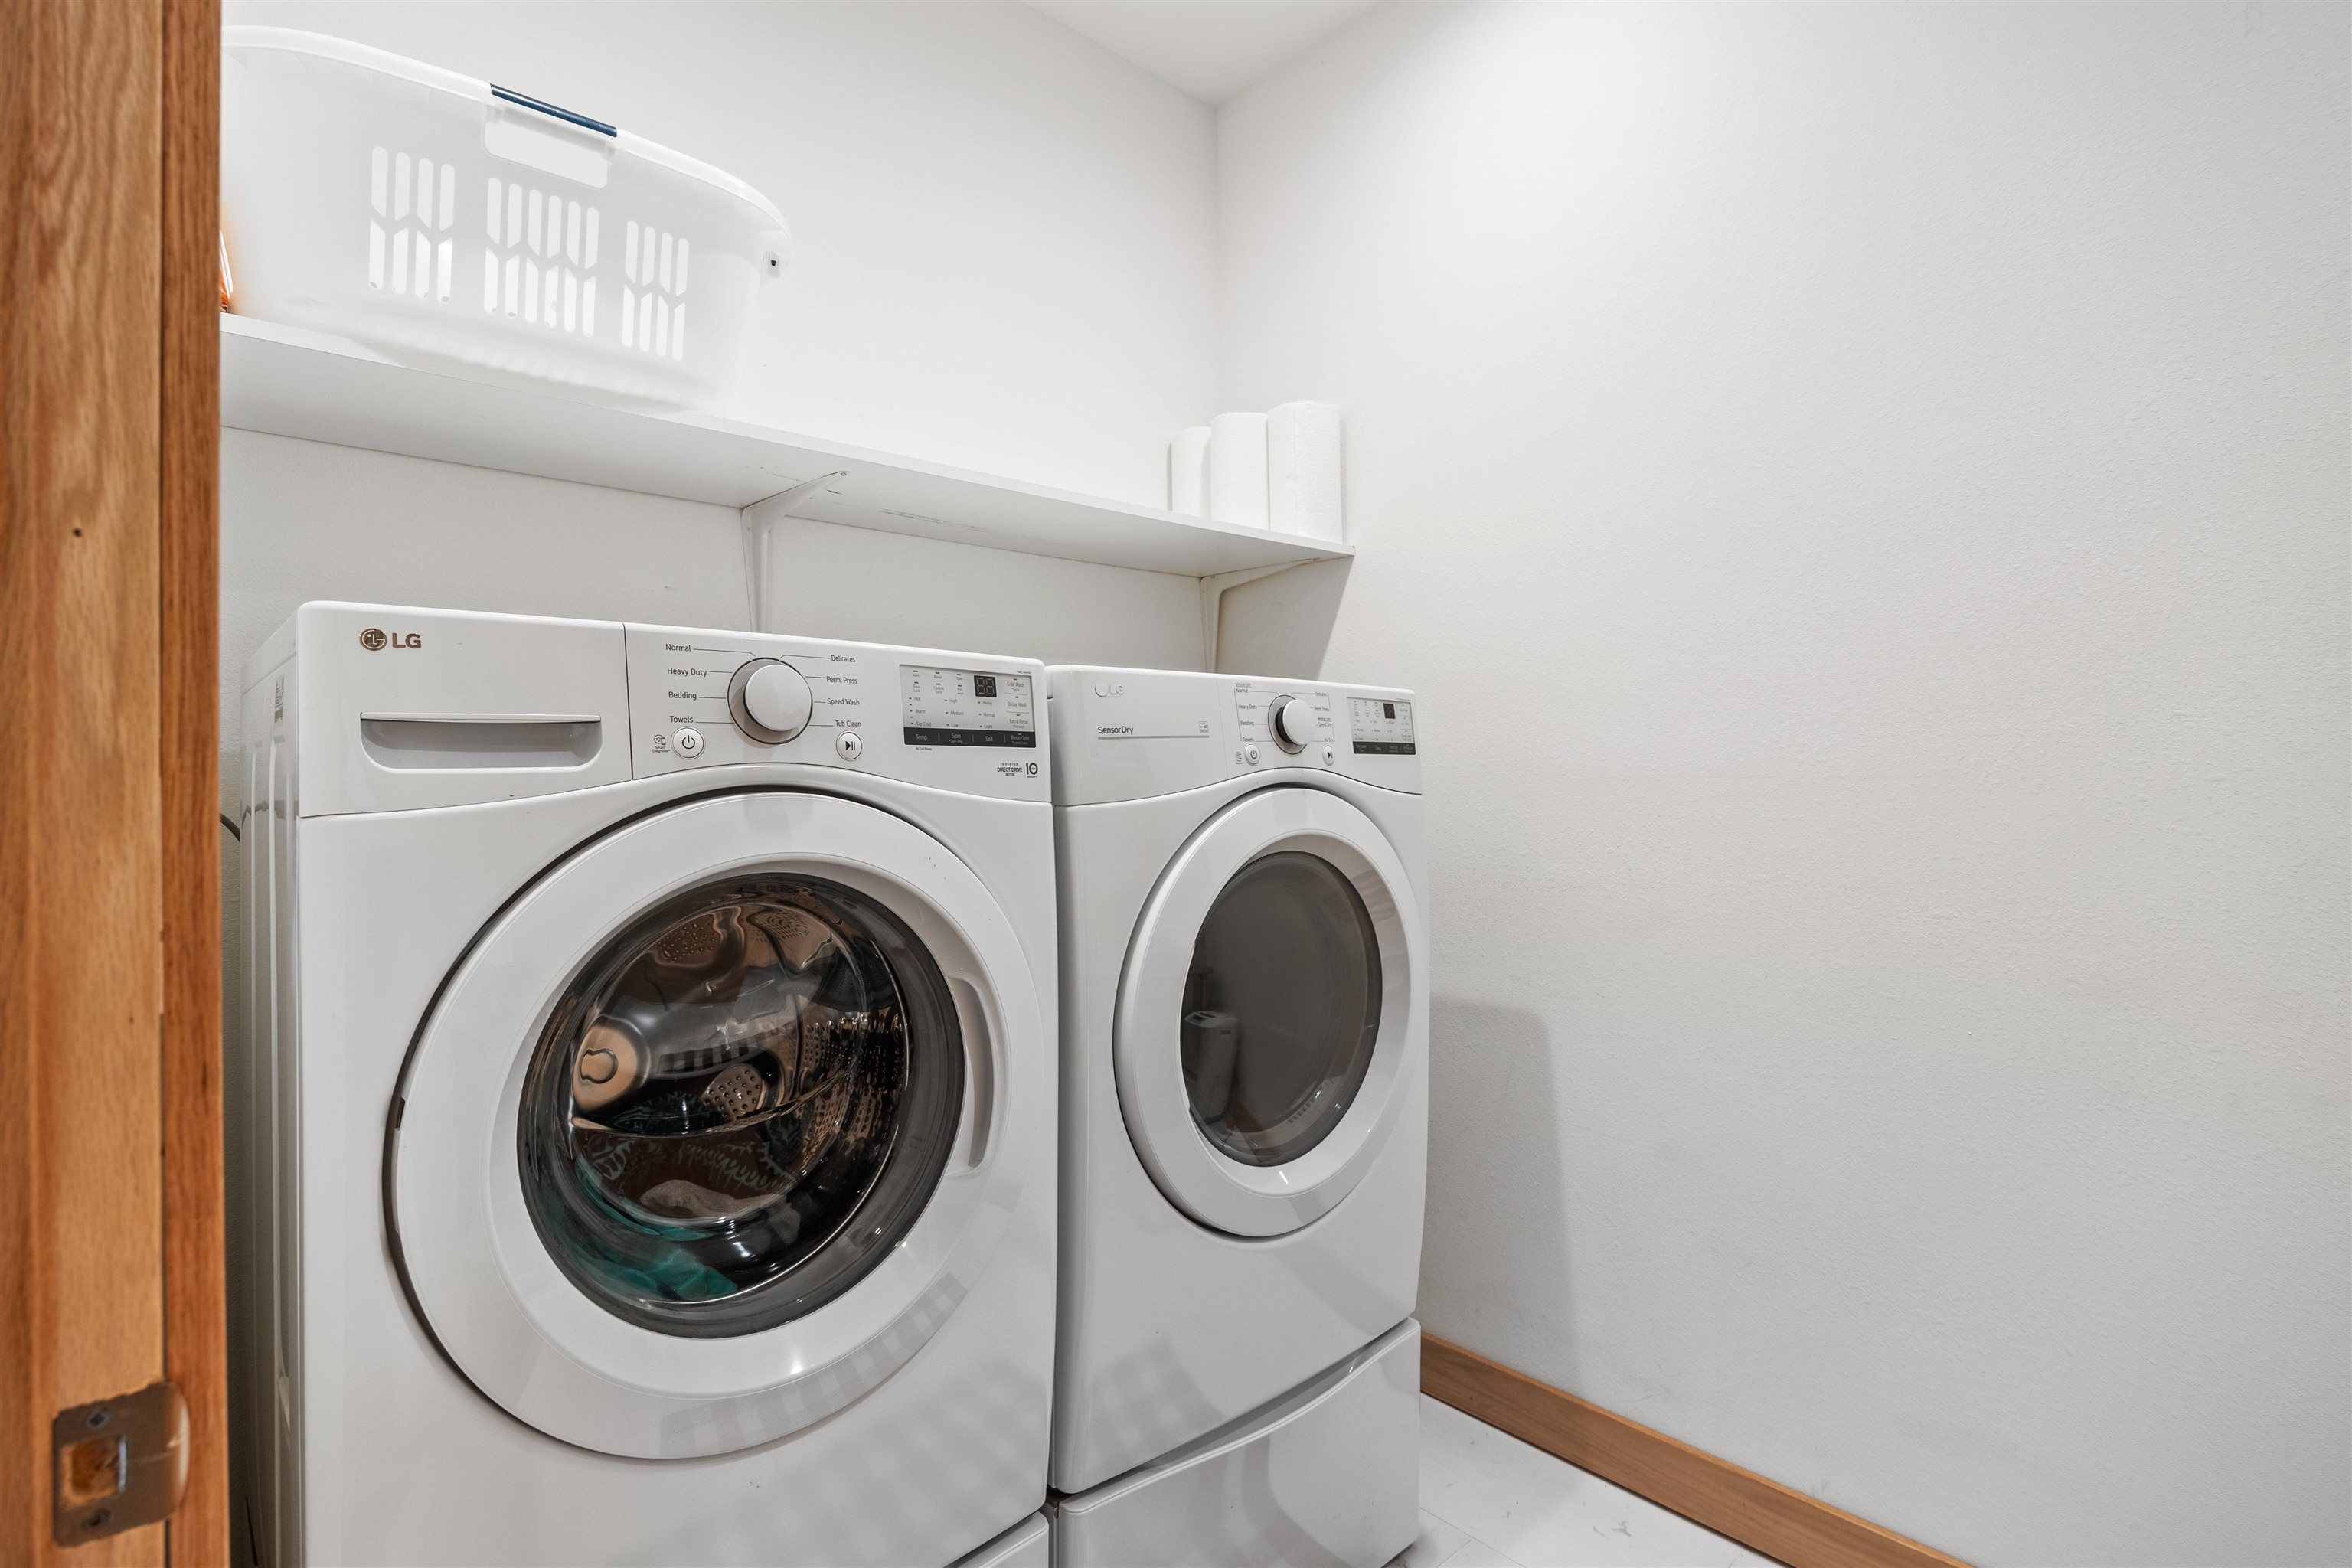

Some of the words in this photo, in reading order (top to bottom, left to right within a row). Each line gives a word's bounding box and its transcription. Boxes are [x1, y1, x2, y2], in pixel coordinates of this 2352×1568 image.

[392, 632, 422, 649] LG
[667, 668, 689, 676] Heavy
[691, 668, 707, 677] Duty
[668, 691, 697, 701] Bedding
[1026, 763, 1038, 775] 10
